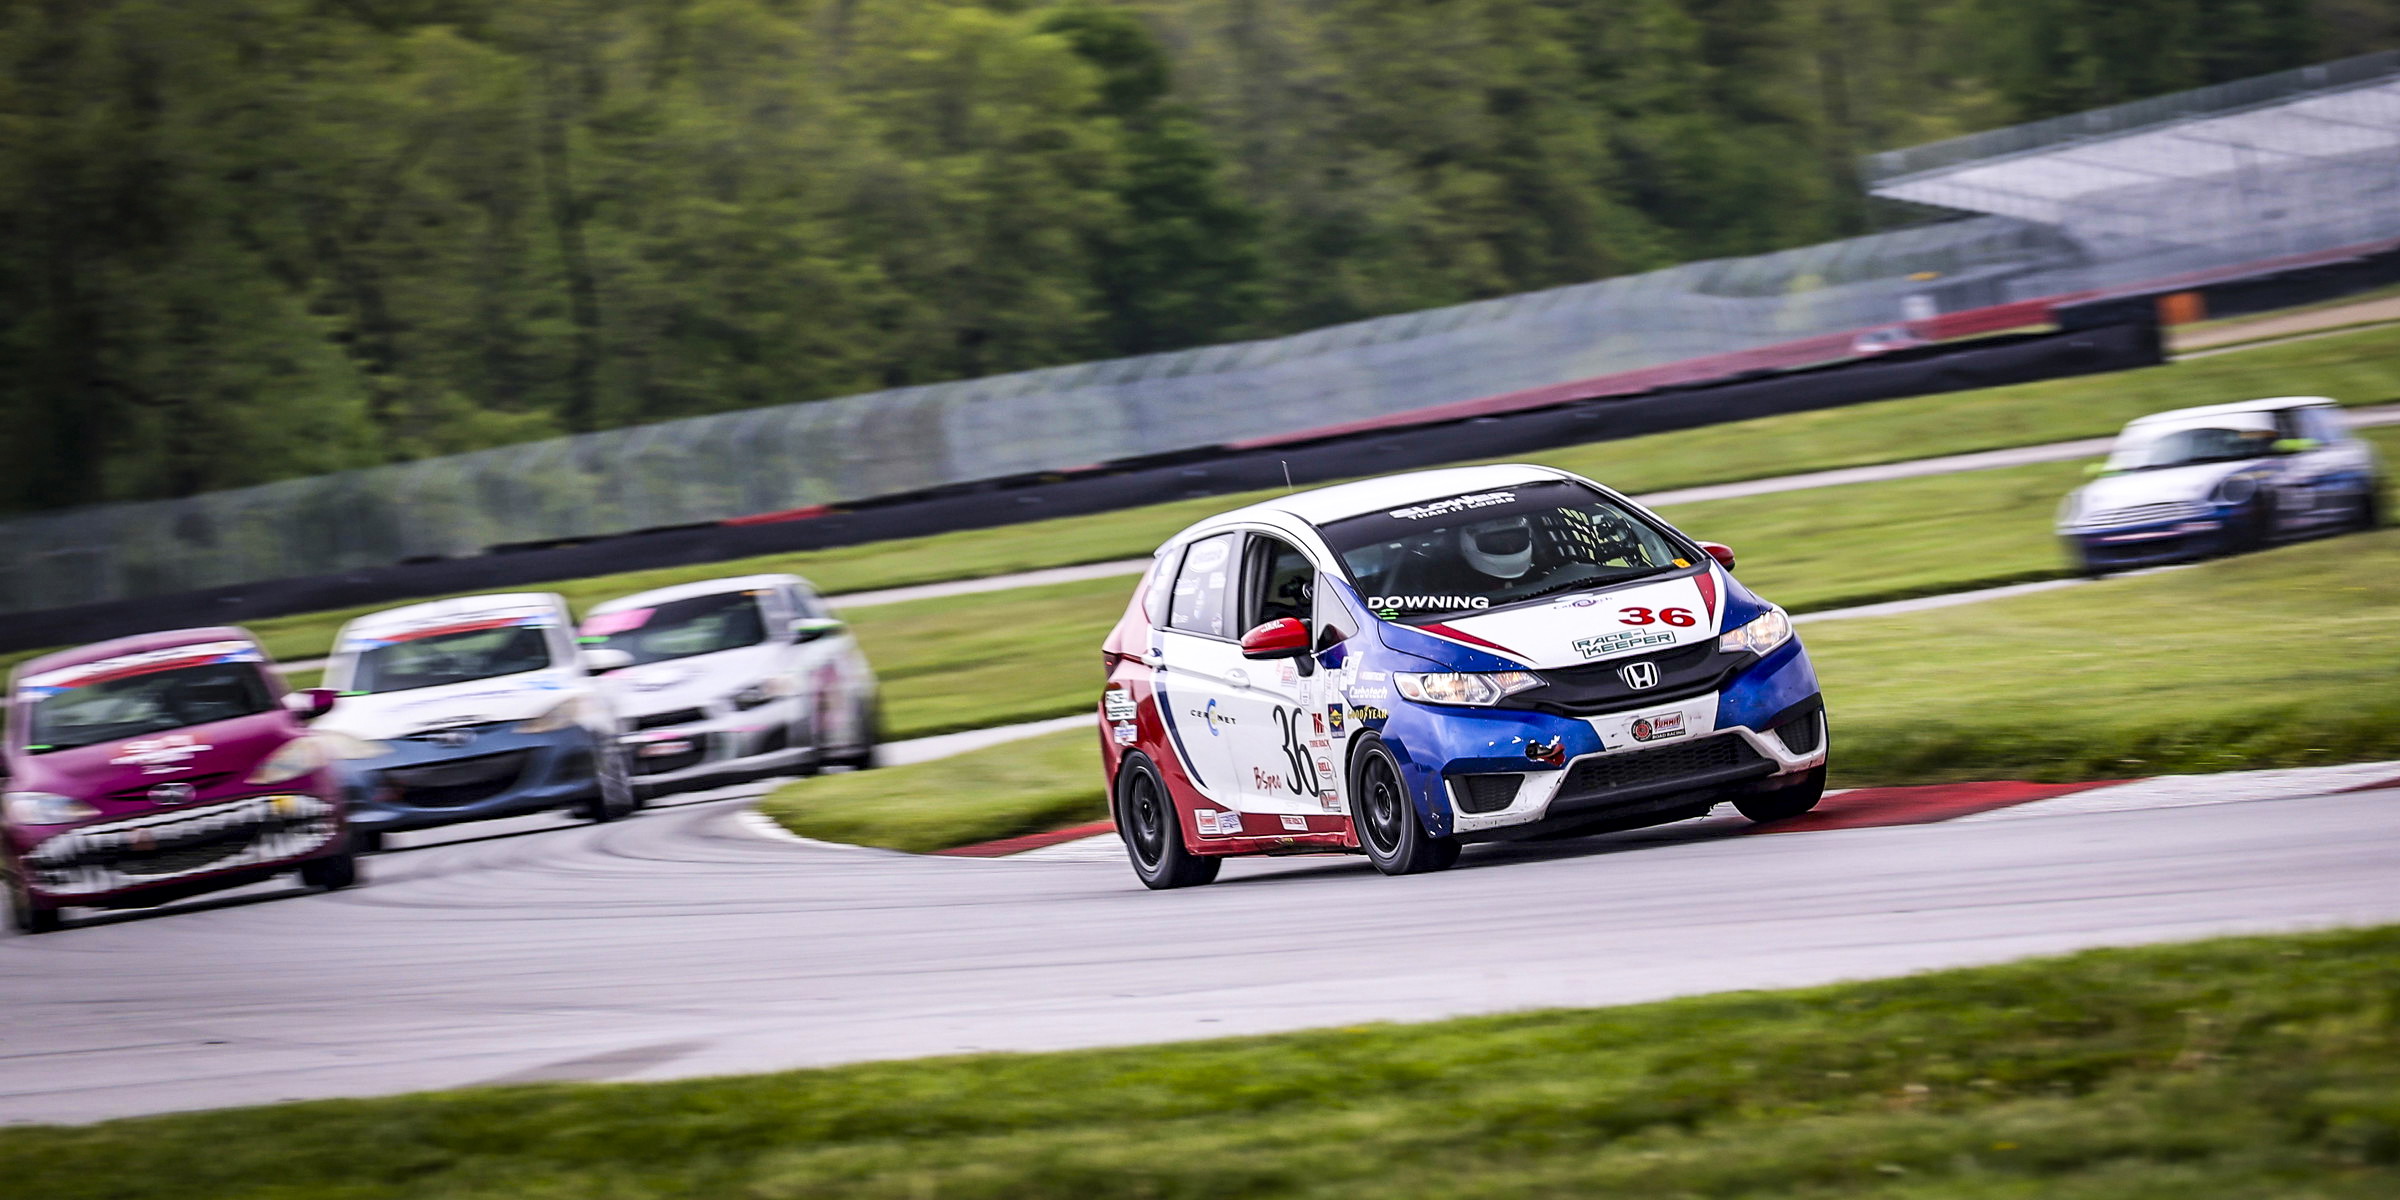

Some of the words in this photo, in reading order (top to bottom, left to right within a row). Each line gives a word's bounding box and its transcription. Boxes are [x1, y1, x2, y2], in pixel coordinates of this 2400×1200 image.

[1407, 508, 1448, 520] THAN
[1367, 596, 1490, 609] DOWNING
[1618, 607, 1696, 627] 36
[1586, 633, 1672, 656] KEEPER
[1273, 705, 1319, 797] 36
[1317, 762, 1331, 772] BELL
